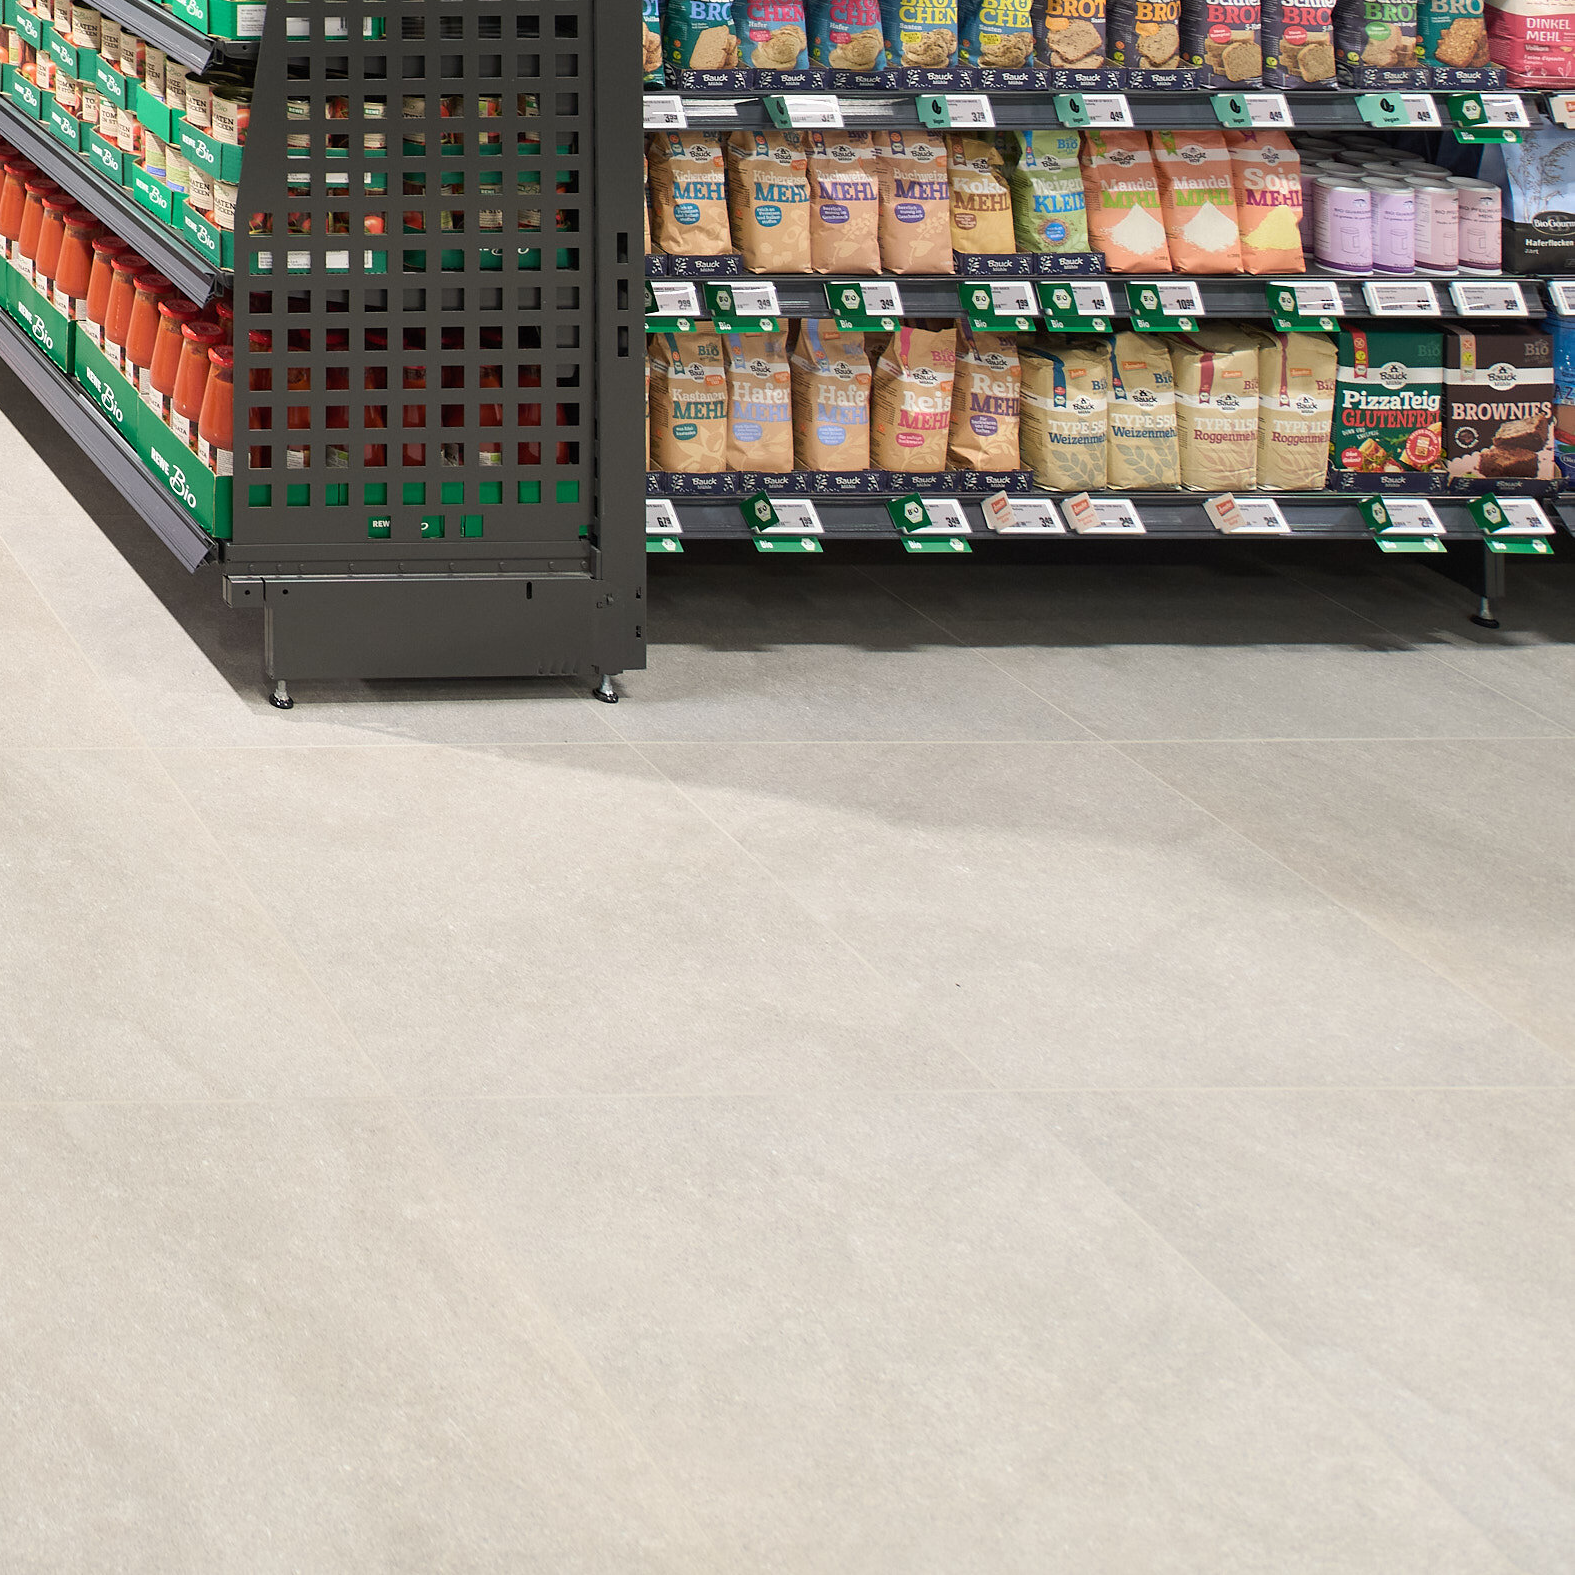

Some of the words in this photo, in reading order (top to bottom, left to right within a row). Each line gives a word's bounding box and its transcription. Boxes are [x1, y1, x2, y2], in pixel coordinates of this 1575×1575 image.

[900, 6, 958, 24] CHEN
[1526, 17, 1571, 30] DINKEL
[1526, 30, 1561, 43] MEHL
[1173, 175, 1231, 190] Mandel
[1243, 167, 1299, 194] Soja
[754, 184, 810, 202] MEHL
[1033, 193, 1086, 212] KLEIE
[1525, 239, 1574, 248] Haferflocken
[903, 390, 951, 411] Reis
[1342, 390, 1441, 411] PizzaTeig
[1111, 413, 1153, 427] TYPE
[1342, 409, 1442, 428] GLUTENFREI
[1451, 402, 1552, 420] BROWNIES
[150, 445, 171, 479] REWE
[169, 464, 198, 511] Bio
